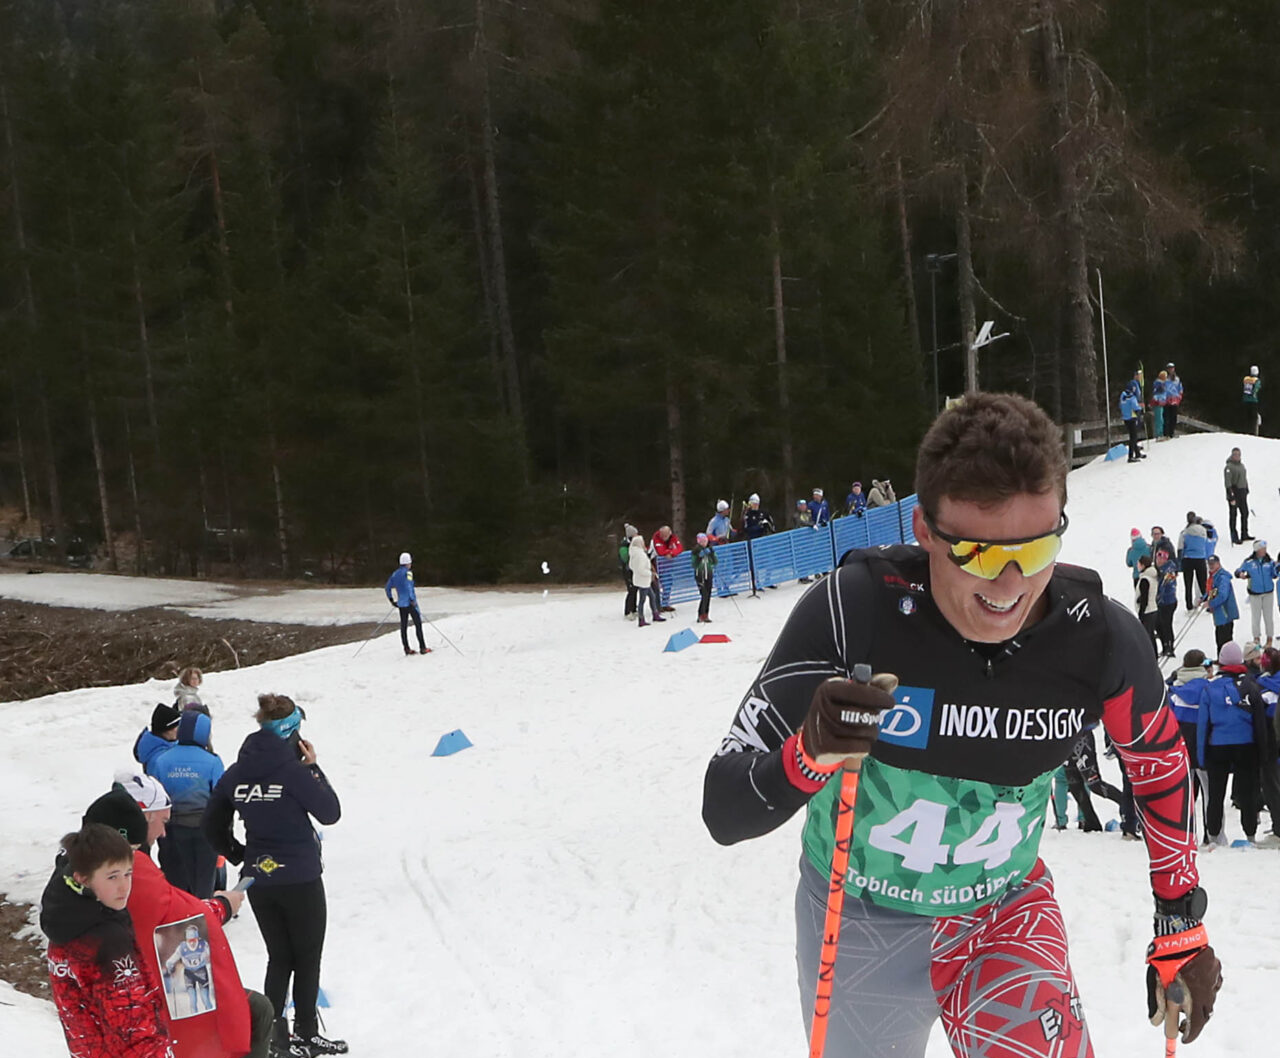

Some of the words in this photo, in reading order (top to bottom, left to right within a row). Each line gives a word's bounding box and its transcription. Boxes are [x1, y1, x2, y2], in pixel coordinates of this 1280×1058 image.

[938, 703, 1000, 739] INOX
[1005, 707, 1086, 741] DESIGN
[847, 866, 924, 904] Toblach
